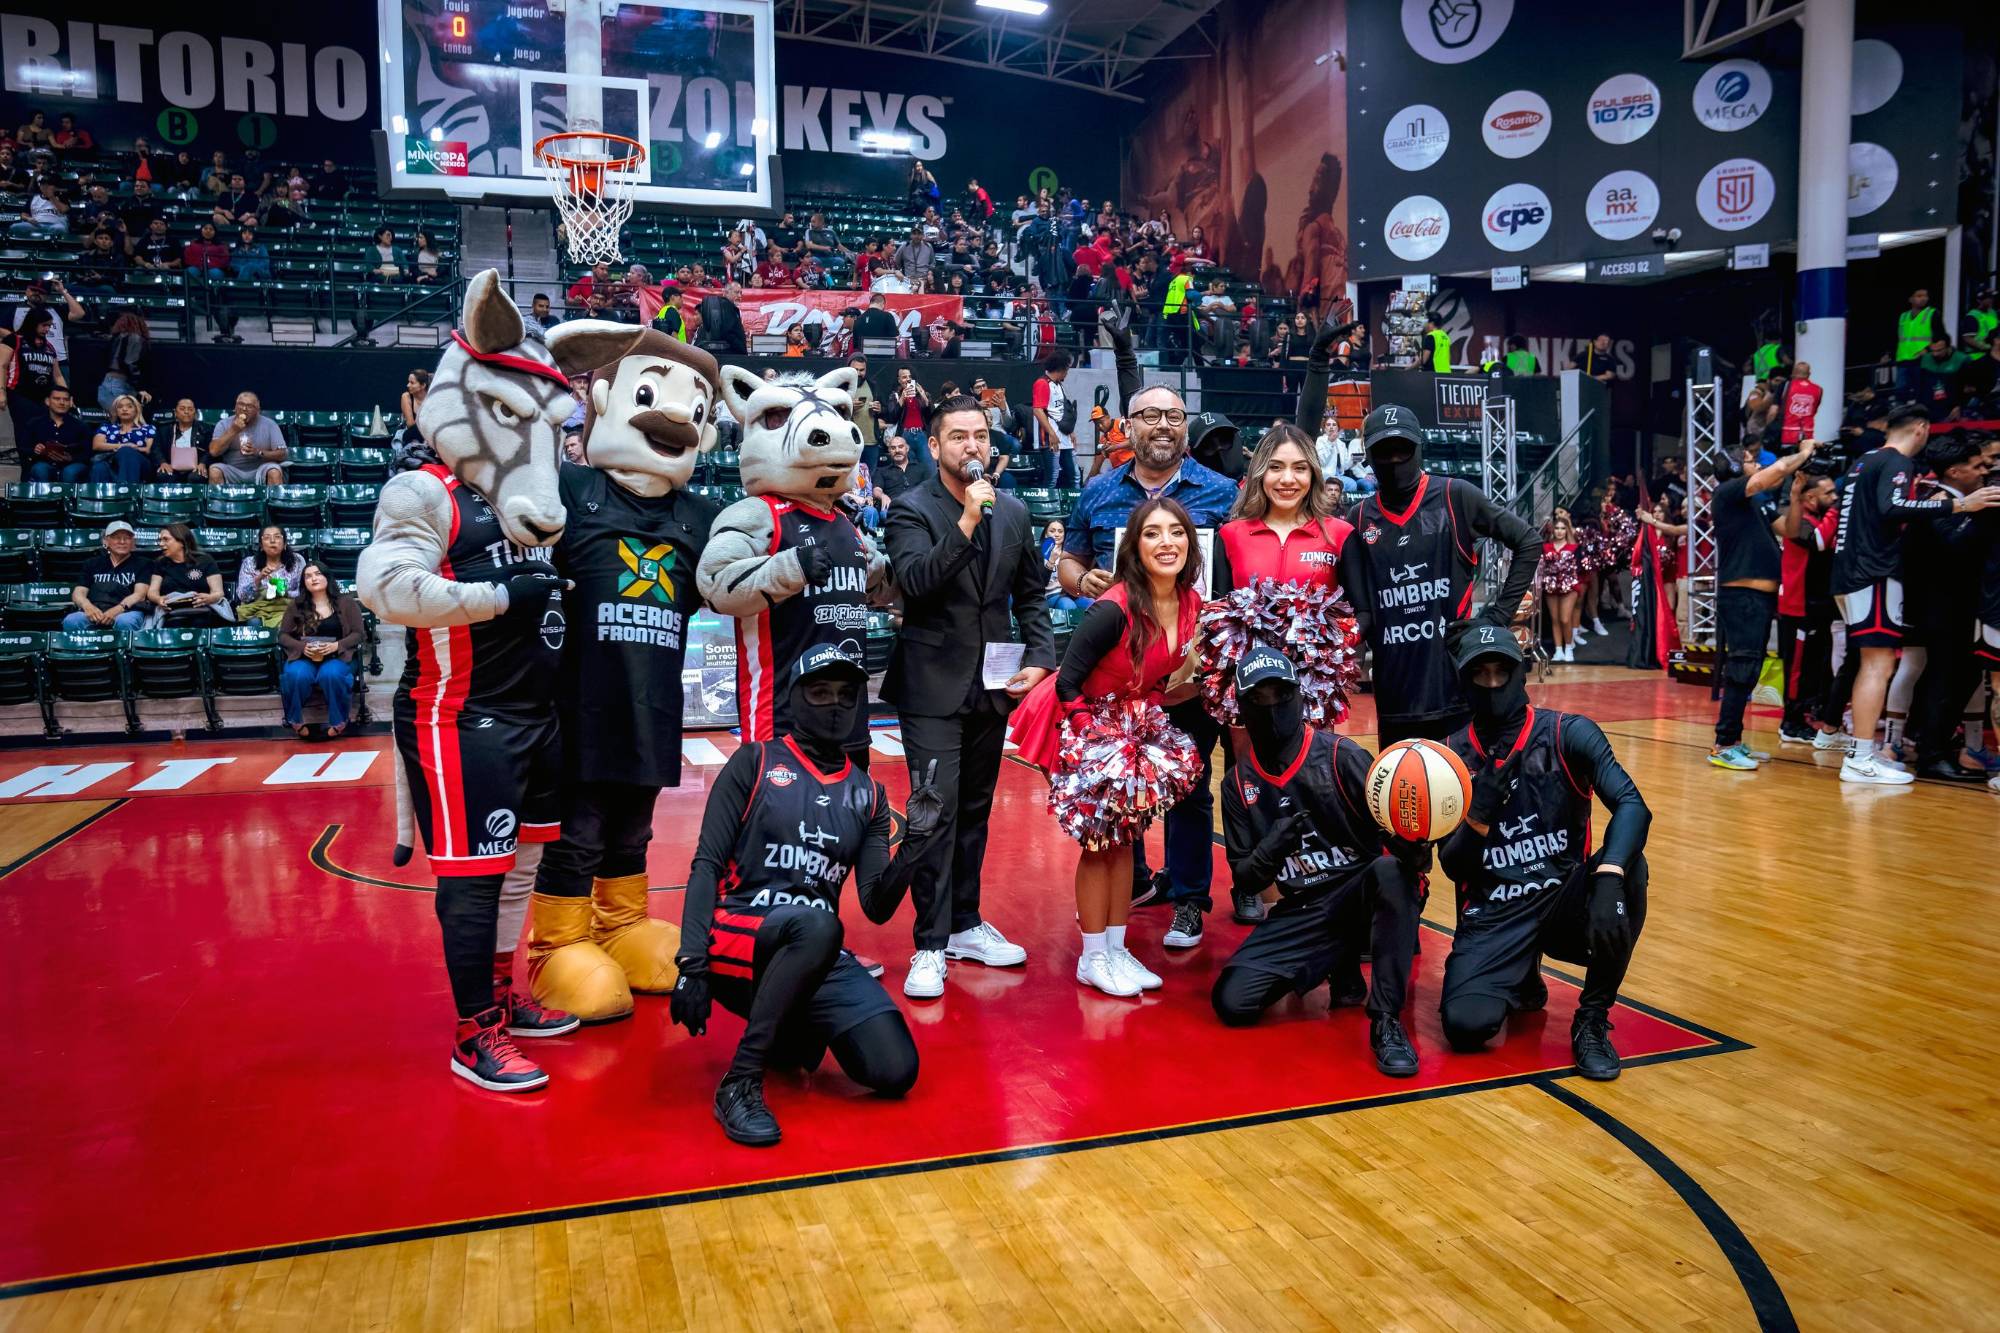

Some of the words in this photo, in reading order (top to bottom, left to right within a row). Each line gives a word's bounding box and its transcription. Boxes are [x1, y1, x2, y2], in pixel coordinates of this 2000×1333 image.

[453, 17, 466, 37] 0
[0, 13, 368, 122] RITORIO
[1495, 114, 1540, 130] Rosarito
[1593, 103, 1654, 124] 107.3
[1704, 103, 1760, 121] MEGA
[168, 111, 188, 138] B
[1386, 139, 1416, 149] GRAND
[1418, 135, 1447, 145] HOTEL
[1606, 201, 1638, 215] mx
[1497, 207, 1545, 236] cpe
[1600, 262, 1635, 276] ACCESO
[1637, 260, 1649, 273] 02
[1834, 482, 1856, 554] TIJUANA
[30, 587, 59, 595] MIKEL
[598, 603, 682, 632] ACEROS
[1383, 620, 1435, 645] ARCO
[809, 650, 849, 666] ZONKE
[1243, 657, 1285, 677] ZONKEYS
[766, 769, 798, 781] ZONKEYS
